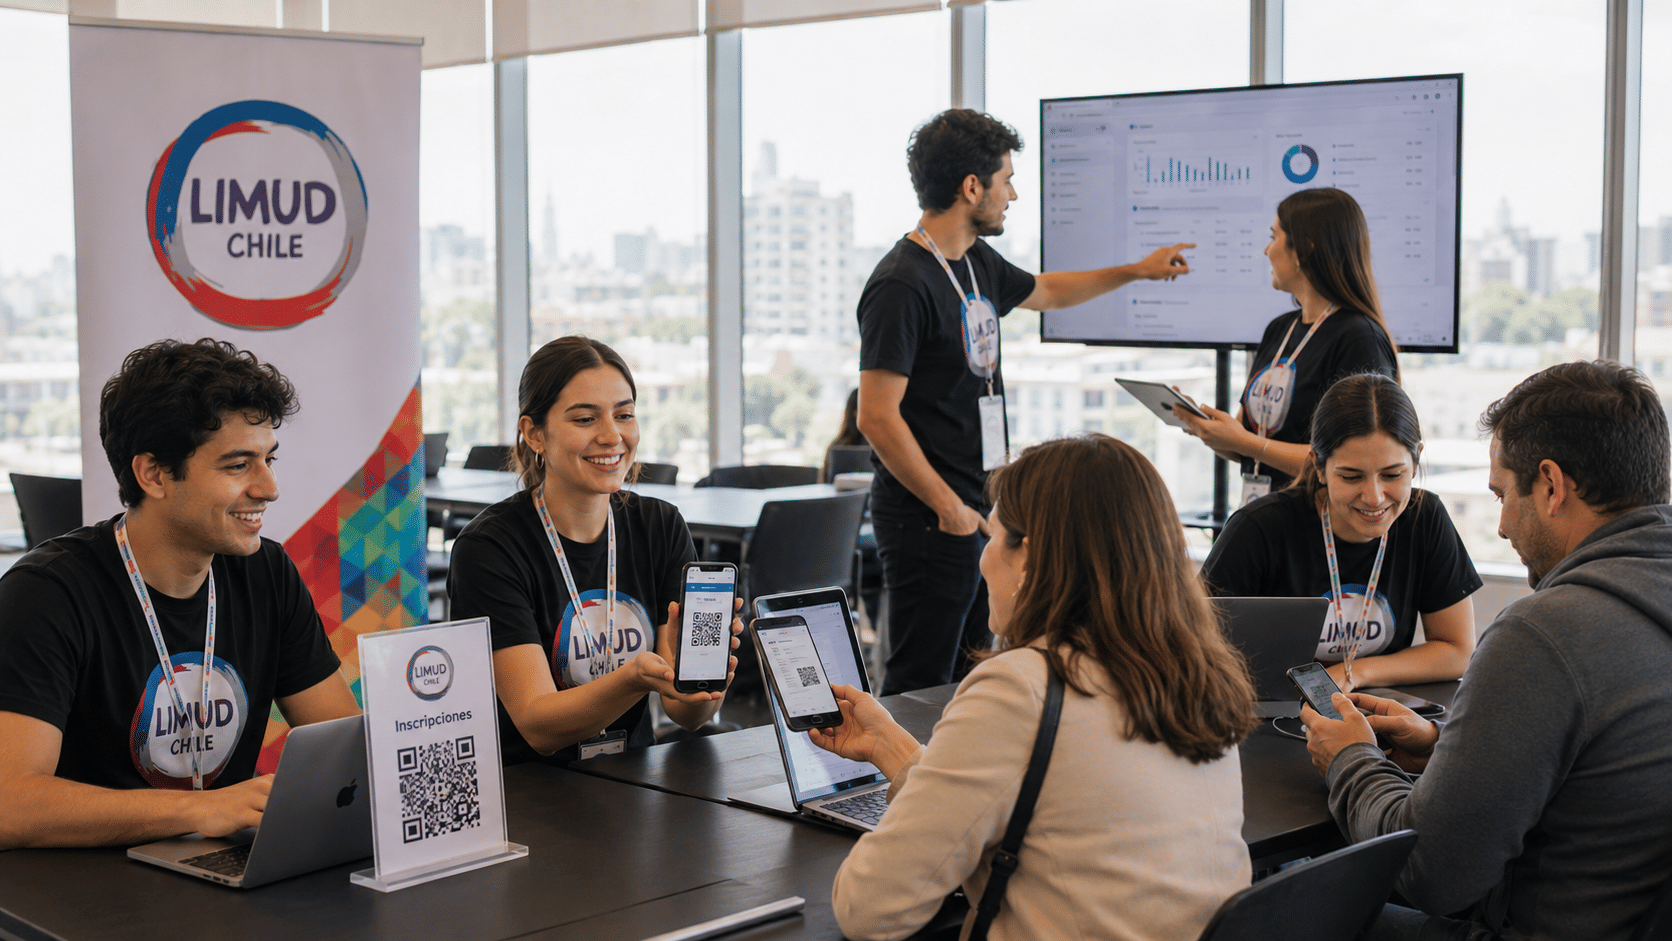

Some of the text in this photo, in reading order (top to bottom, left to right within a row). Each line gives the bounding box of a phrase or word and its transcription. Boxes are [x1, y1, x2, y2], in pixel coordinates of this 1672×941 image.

[190, 178, 337, 225] LIMUD
[227, 232, 303, 258] CHILE
[414, 663, 447, 678] LIMUD
[155, 698, 234, 737] LIMUD
[395, 710, 472, 733] Inscripciones
